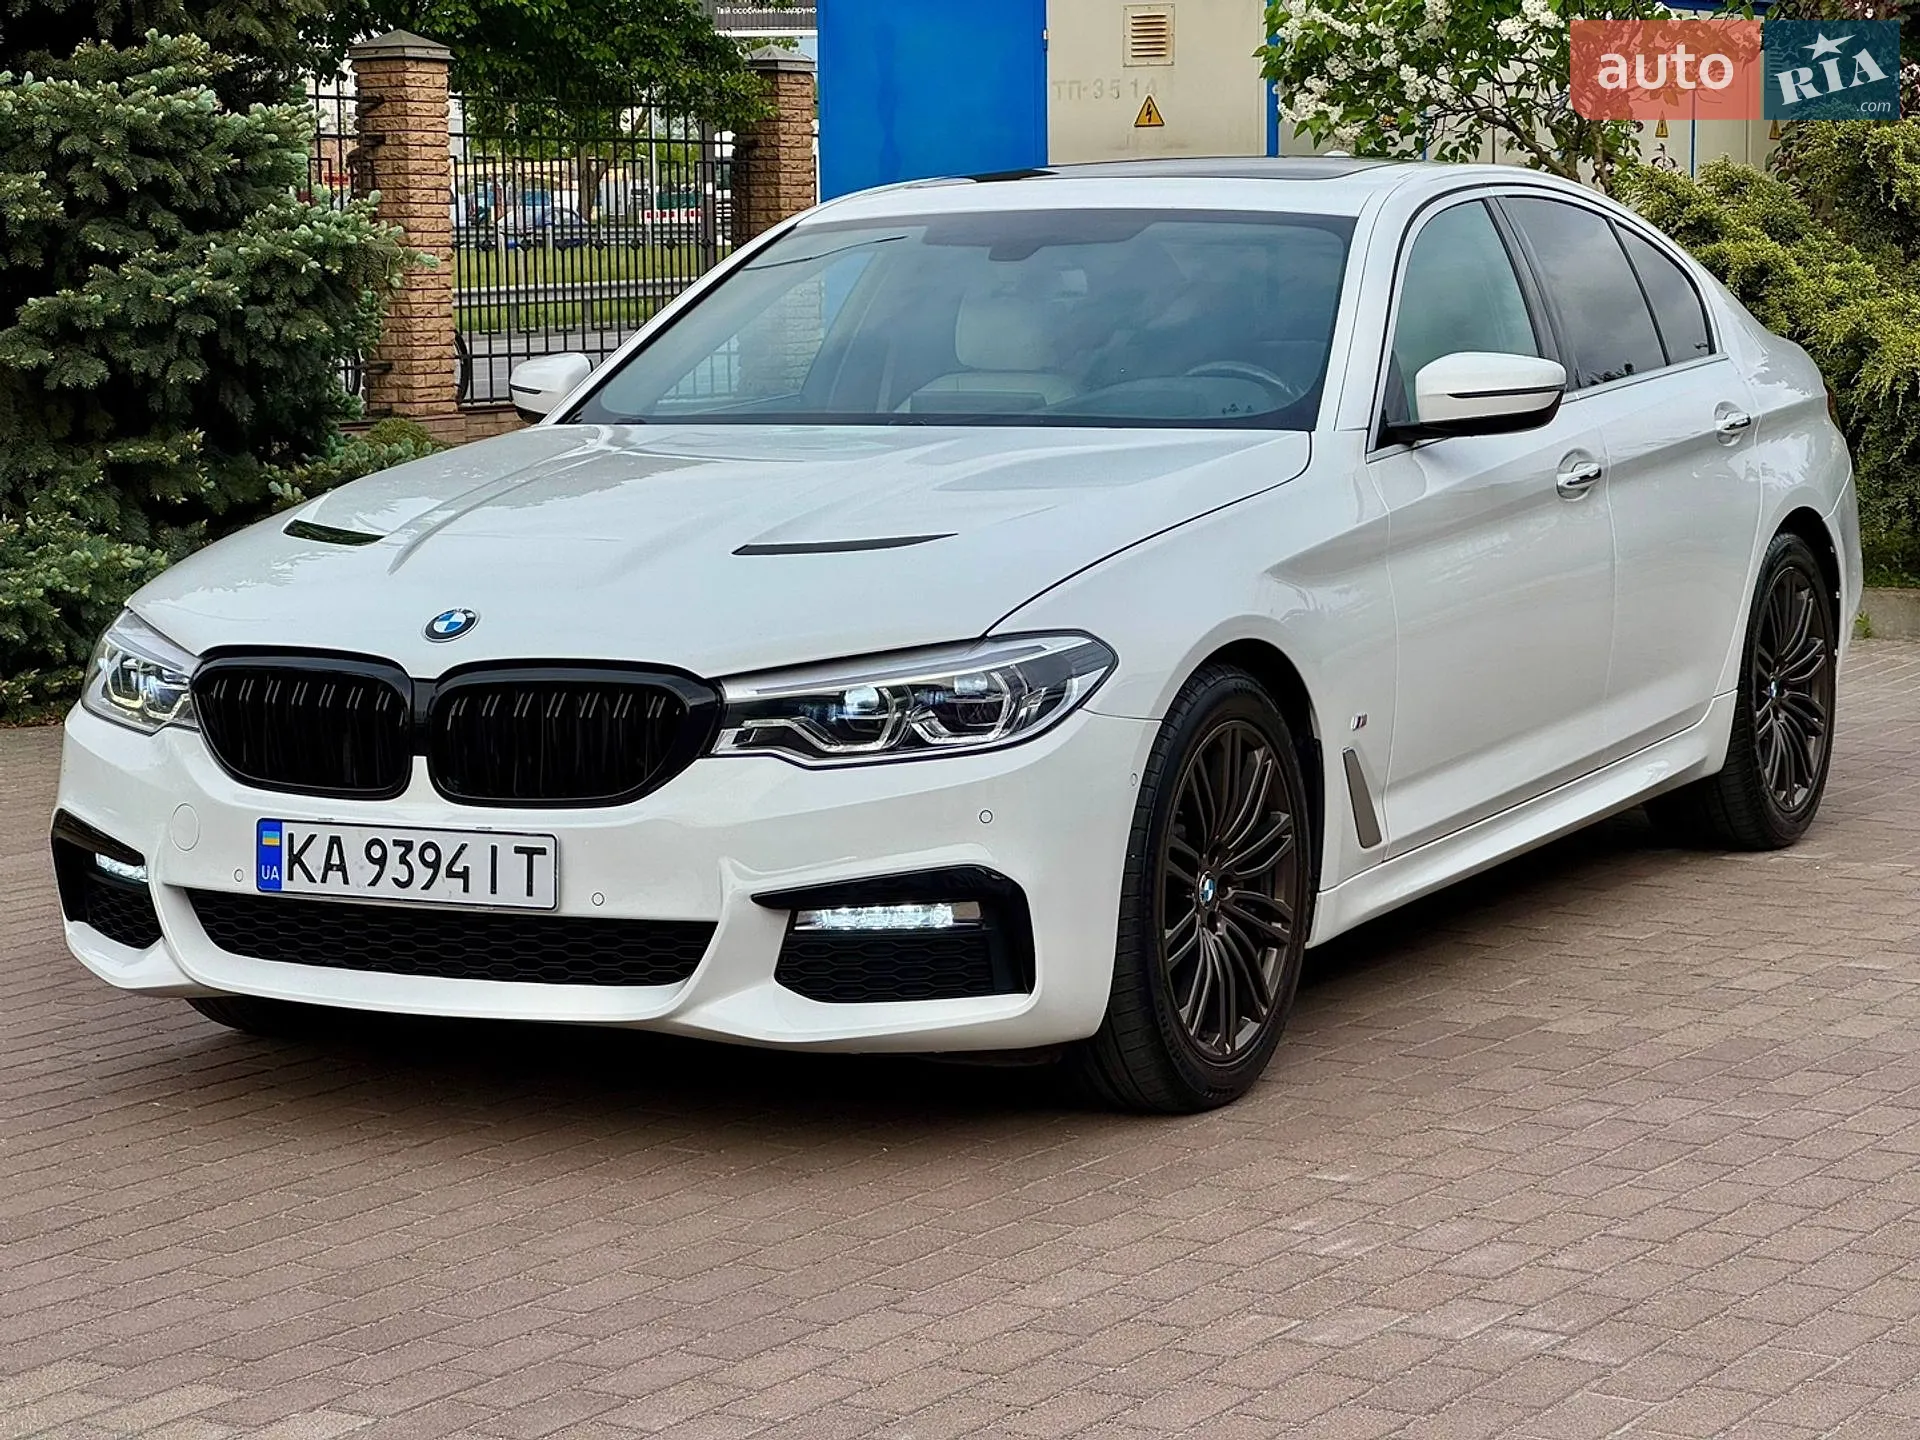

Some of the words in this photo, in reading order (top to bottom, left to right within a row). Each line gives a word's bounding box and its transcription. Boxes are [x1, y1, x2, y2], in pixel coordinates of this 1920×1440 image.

[261, 865, 280, 881] UA
[287, 832, 350, 886] KA
[364, 837, 470, 893] 9394
